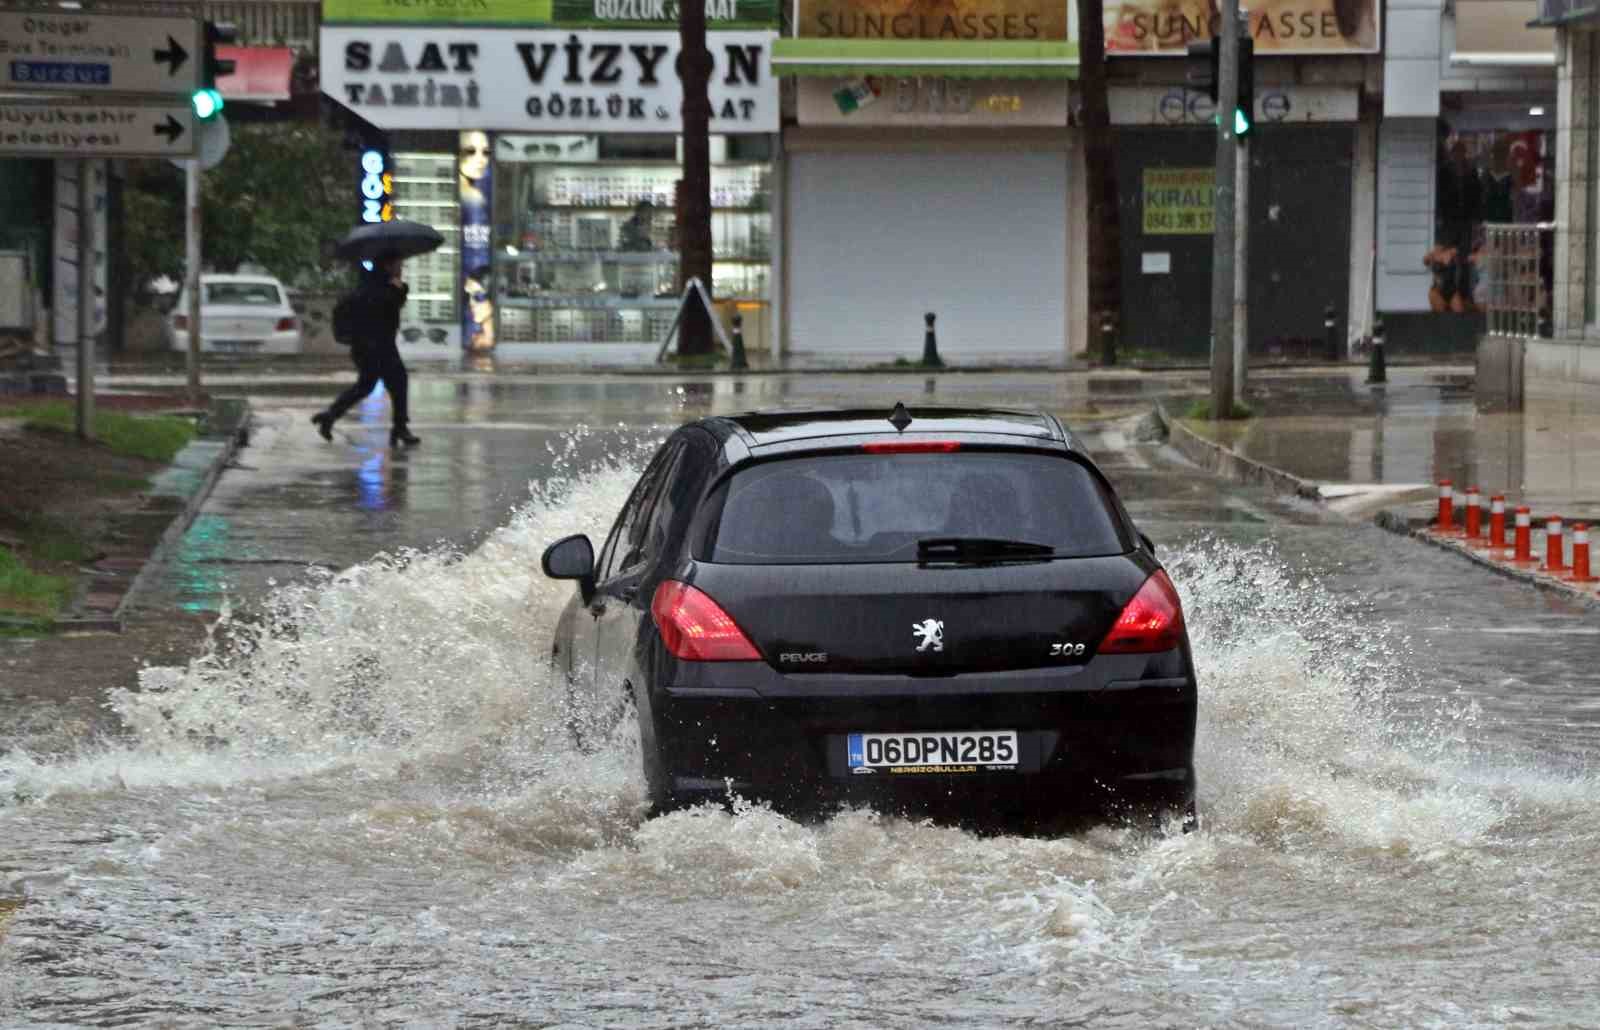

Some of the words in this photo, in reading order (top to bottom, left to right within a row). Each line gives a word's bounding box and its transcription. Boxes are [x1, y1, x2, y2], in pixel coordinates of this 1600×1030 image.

[816, 12, 1039, 39] SUNGLASSES
[1133, 12, 1341, 39] SUNASSE
[345, 42, 478, 71] SAAT
[16, 64, 105, 81] Burdur
[525, 94, 645, 118] GÖZLÜK
[0, 130, 119, 147] elediyesi
[1147, 188, 1214, 208] KIRALI
[779, 652, 828, 663] PEUGE
[1049, 642, 1086, 656] 308
[866, 735, 1014, 764] 06DPN285
